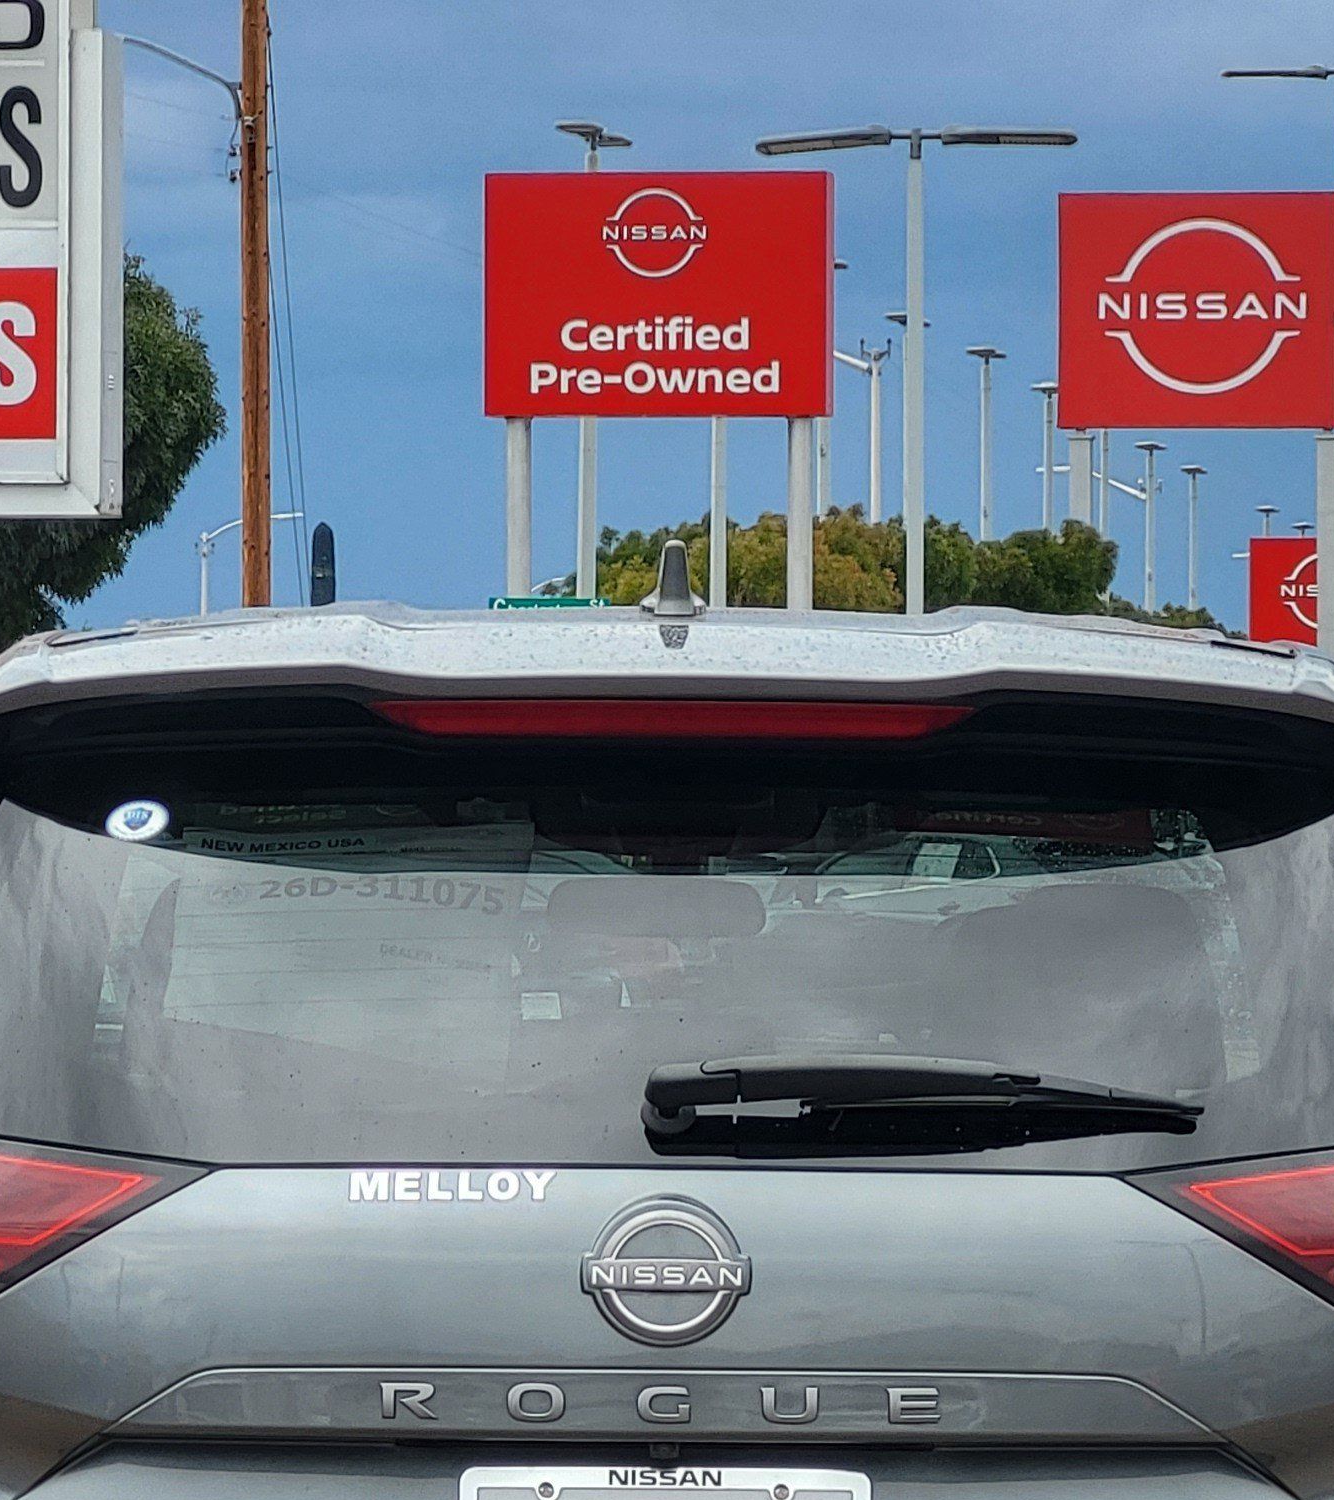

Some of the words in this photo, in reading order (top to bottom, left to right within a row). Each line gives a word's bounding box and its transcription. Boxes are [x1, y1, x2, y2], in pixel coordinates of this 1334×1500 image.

[602, 224, 708, 241] NISSAN
[1098, 292, 1308, 320] NISSAN
[560, 316, 750, 351] Certified
[529, 359, 781, 395] Pre-Owned
[200, 837, 245, 852] NEW
[249, 838, 322, 852] MEXICO
[327, 837, 366, 848] USA
[258, 875, 506, 916] 26D-311075
[348, 1170, 556, 1202] MELLOY
[592, 1264, 742, 1288] NISSAN
[380, 1382, 940, 1425] ROGUE
[608, 1469, 722, 1487] NISSAN
